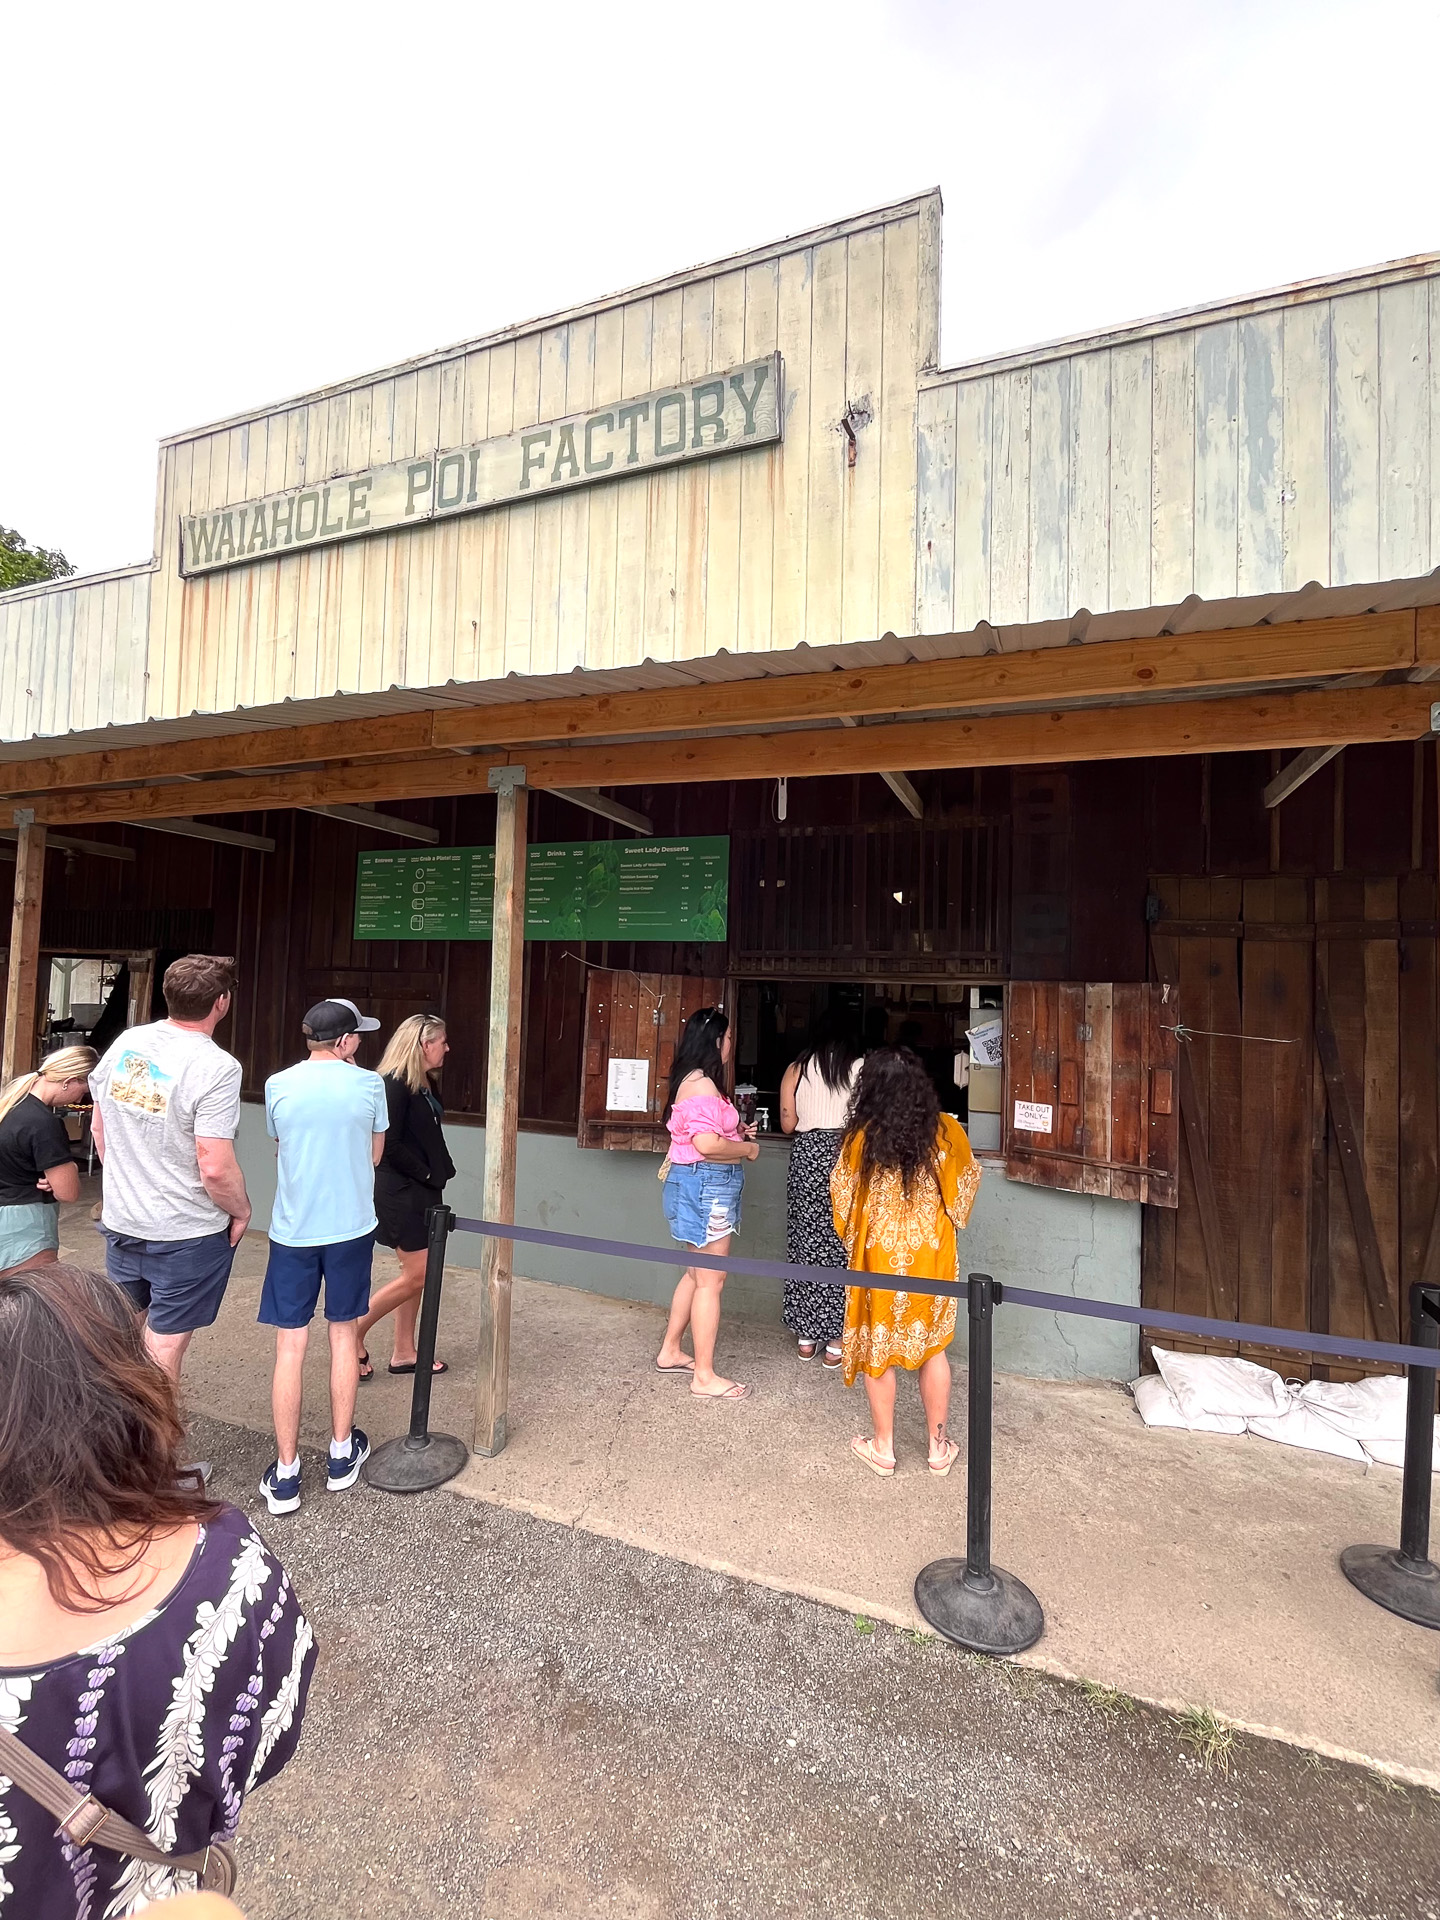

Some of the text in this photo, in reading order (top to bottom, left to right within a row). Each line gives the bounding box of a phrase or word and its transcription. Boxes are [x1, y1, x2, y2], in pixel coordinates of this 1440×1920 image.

[188, 365, 768, 566] WAIAHOLE POI FACTORY
[1017, 1102, 1050, 1113] TAKE OUT
